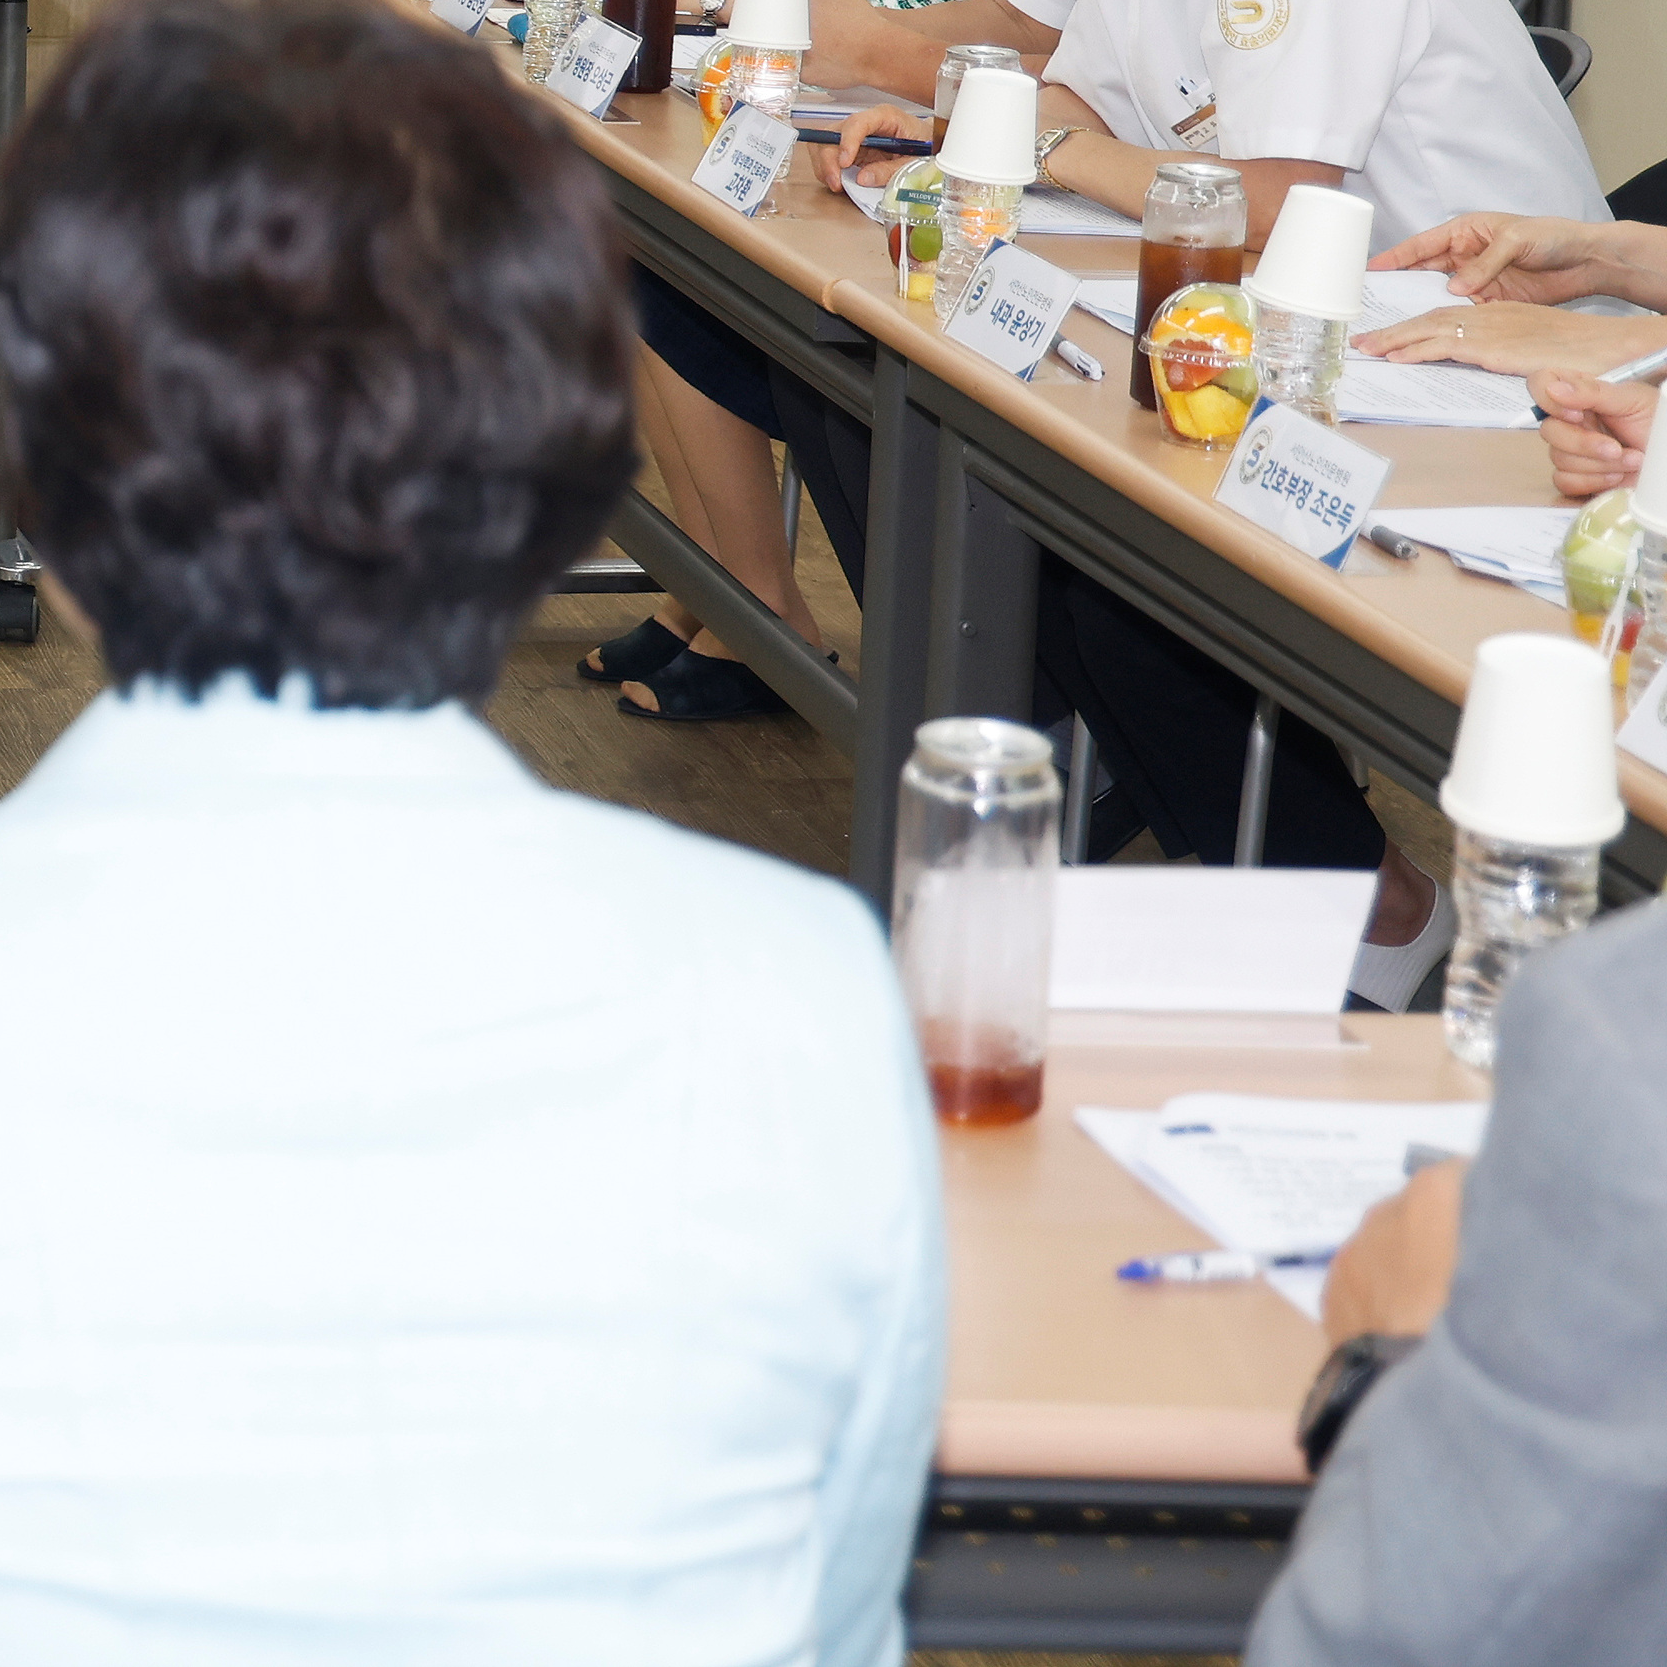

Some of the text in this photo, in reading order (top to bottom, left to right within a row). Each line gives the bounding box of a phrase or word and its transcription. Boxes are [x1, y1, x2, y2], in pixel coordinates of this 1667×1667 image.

[572, 55, 614, 93] 병원장 오상근
[990, 298, 1046, 348] 내과 윤성기
[1291, 443, 1352, 487] 서안산노인전문병원
[1260, 459, 1355, 535] 간호부장 조은득
